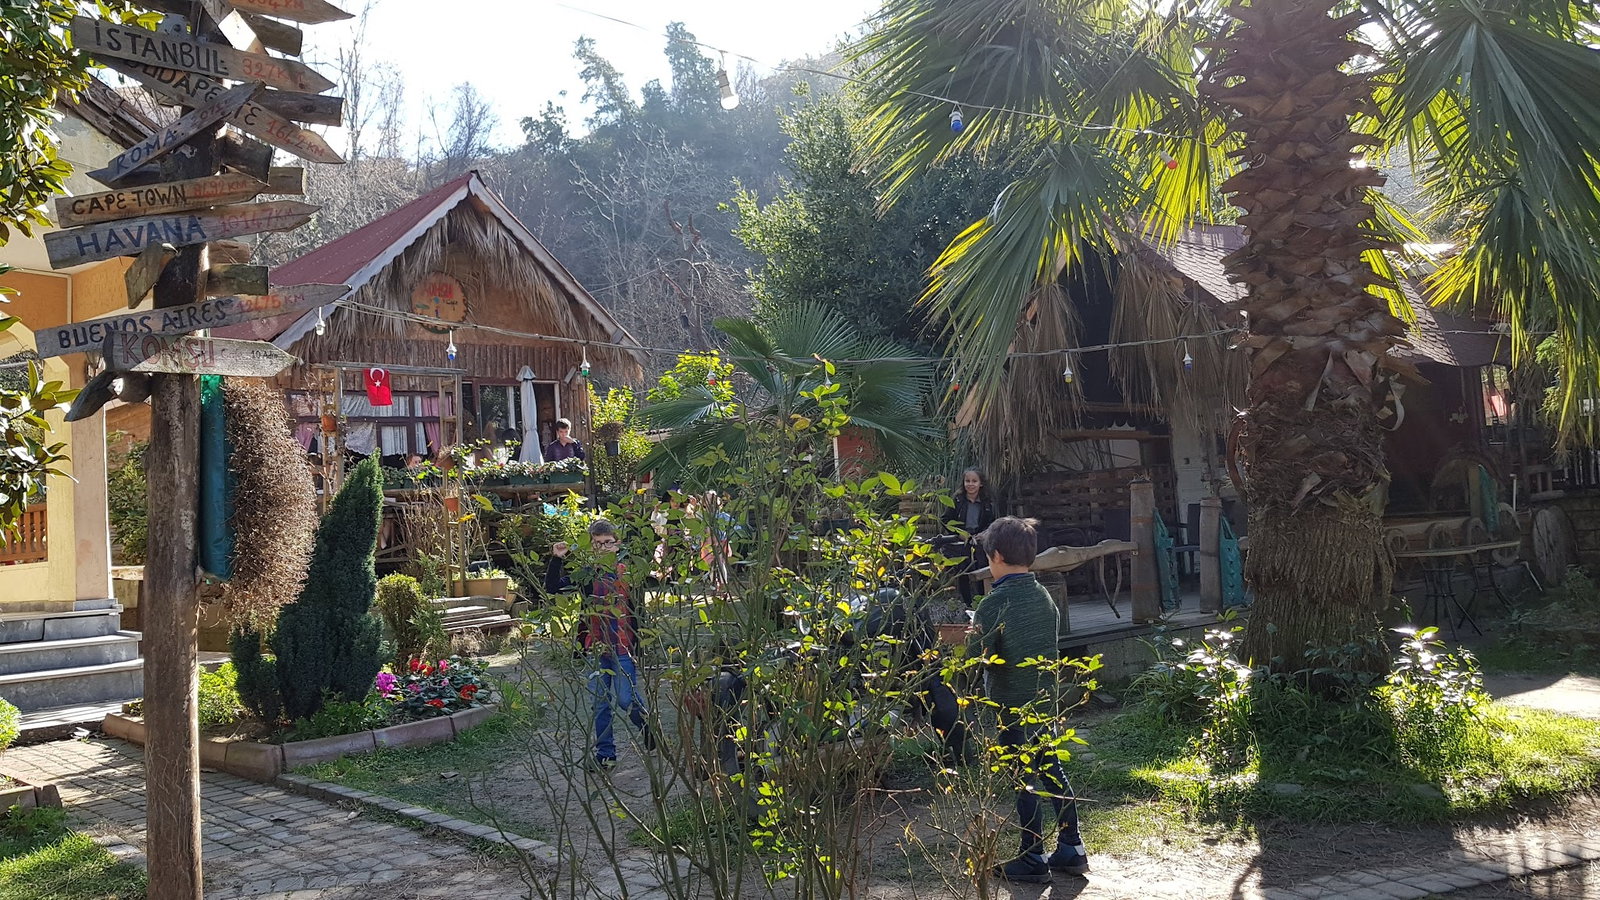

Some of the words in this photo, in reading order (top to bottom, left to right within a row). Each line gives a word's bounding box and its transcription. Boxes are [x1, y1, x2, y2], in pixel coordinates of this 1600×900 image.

[94, 20, 229, 76] İSTANBUL
[115, 129, 177, 174] ROMA
[72, 192, 127, 215] CAPE
[131, 184, 187, 207] TOWN
[75, 214, 207, 256] HAVANA
[58, 315, 152, 349] BUENOS
[161, 299, 226, 331] AIRES
